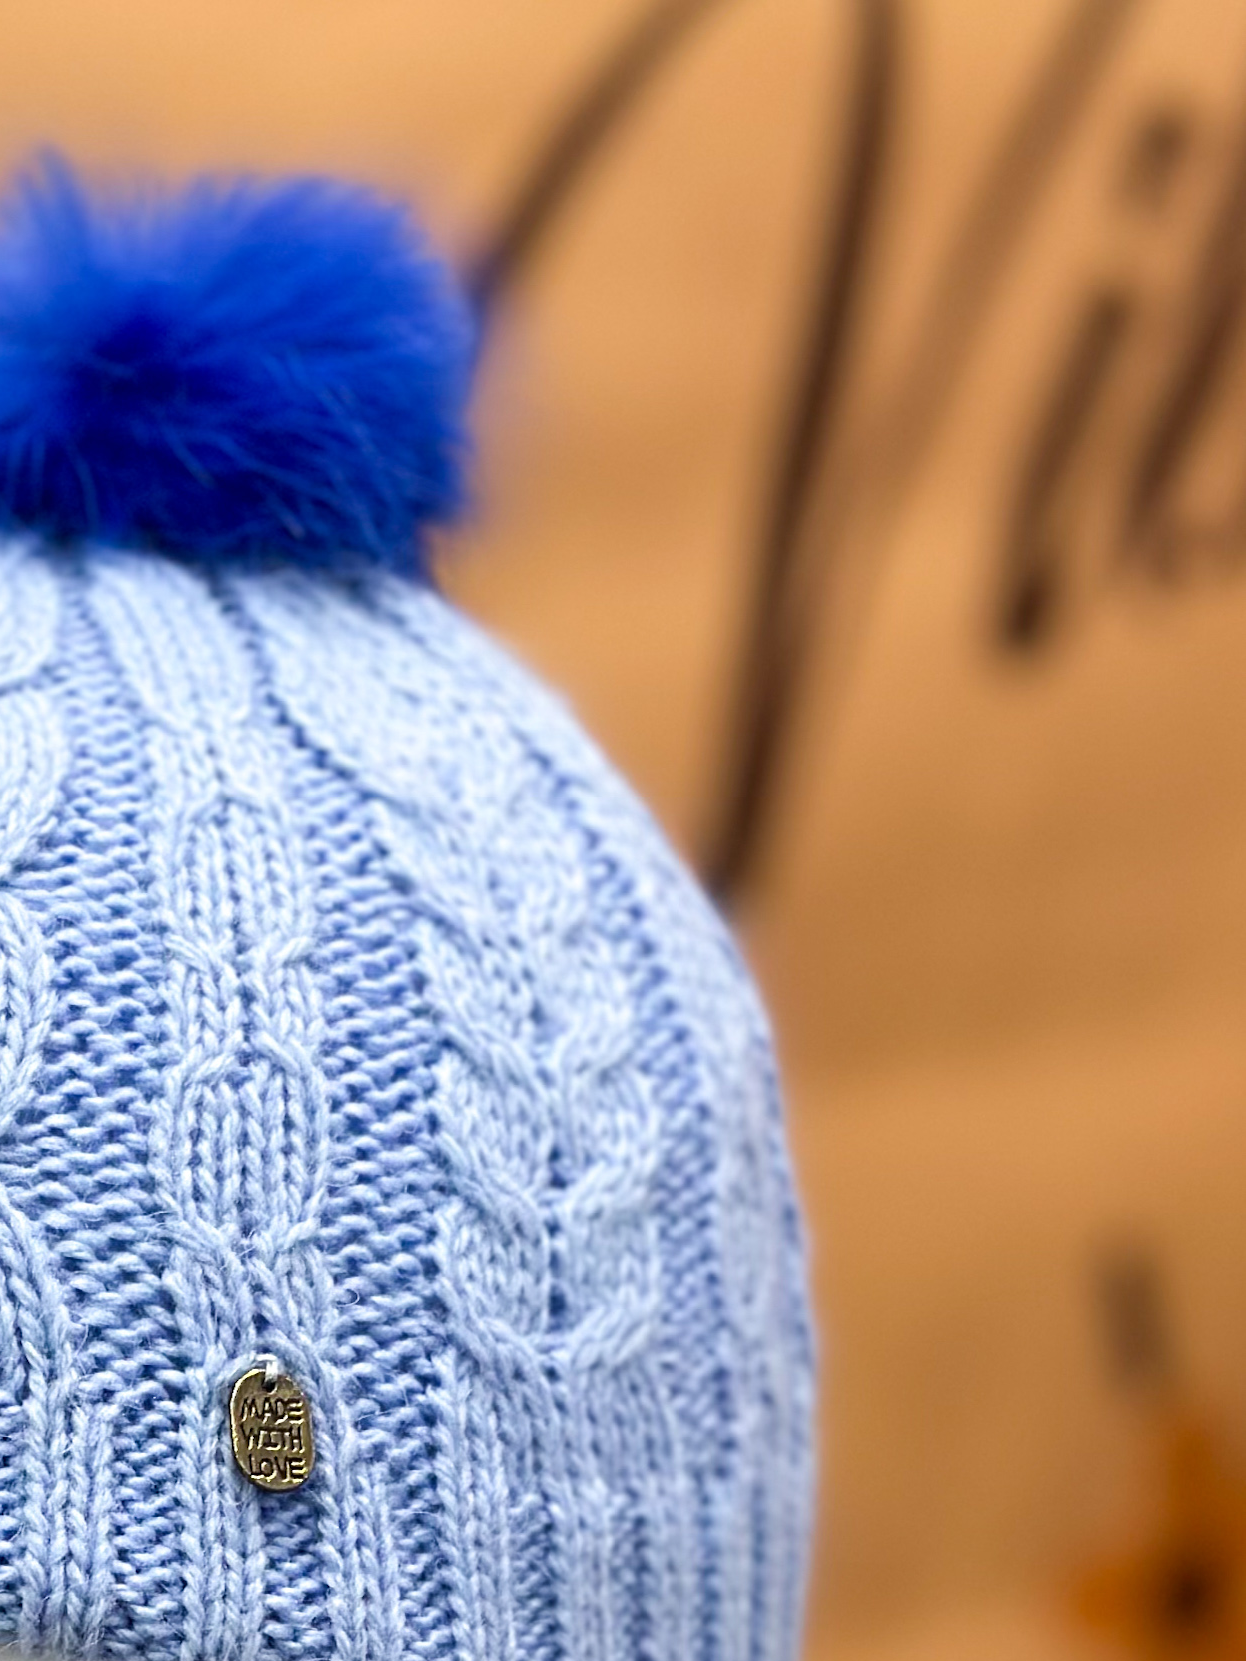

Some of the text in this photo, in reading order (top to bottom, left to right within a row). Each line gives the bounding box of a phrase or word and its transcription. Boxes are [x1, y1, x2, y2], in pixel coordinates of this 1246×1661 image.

[241, 1397, 304, 1424] MADE
[240, 1425, 305, 1453] WITH
[248, 1453, 307, 1482] LOVE
